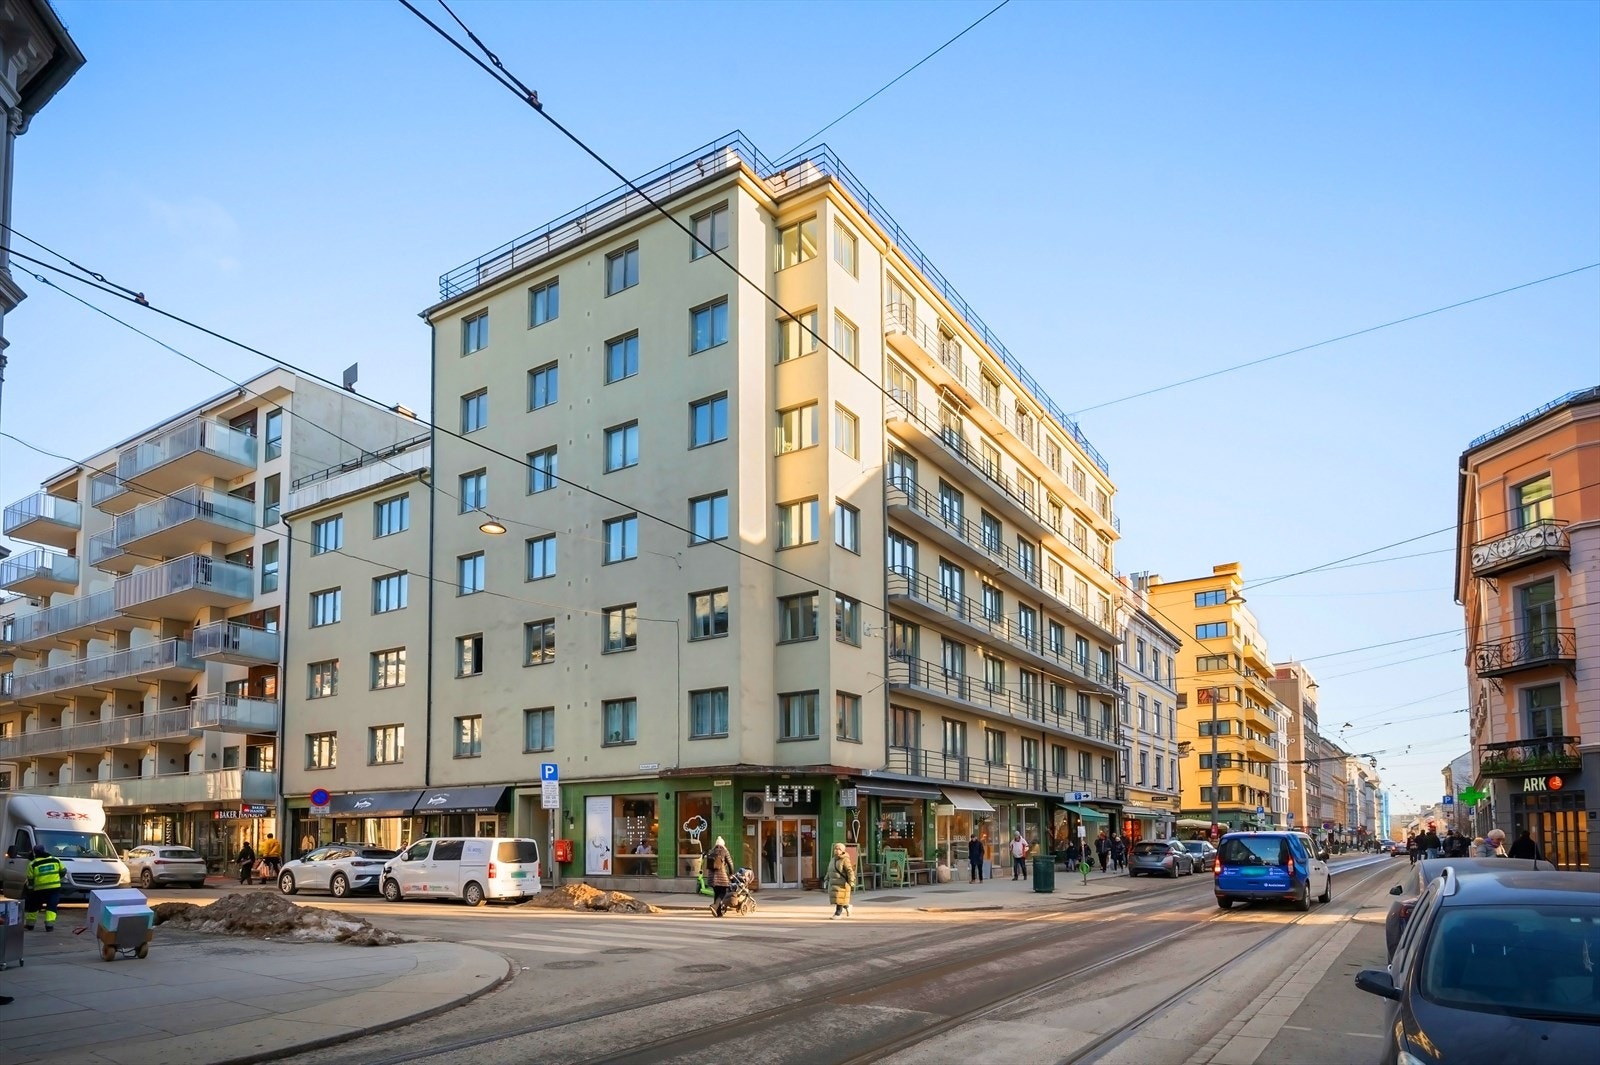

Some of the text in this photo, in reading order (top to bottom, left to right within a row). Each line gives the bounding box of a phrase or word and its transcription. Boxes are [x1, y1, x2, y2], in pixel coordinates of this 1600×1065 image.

[545, 766, 554, 778] P
[1523, 777, 1547, 791] ARK
[765, 785, 815, 802] LETT
[841, 790, 853, 798] LE
[46, 811, 88, 819] GPX
[889, 821, 916, 839] LETT
